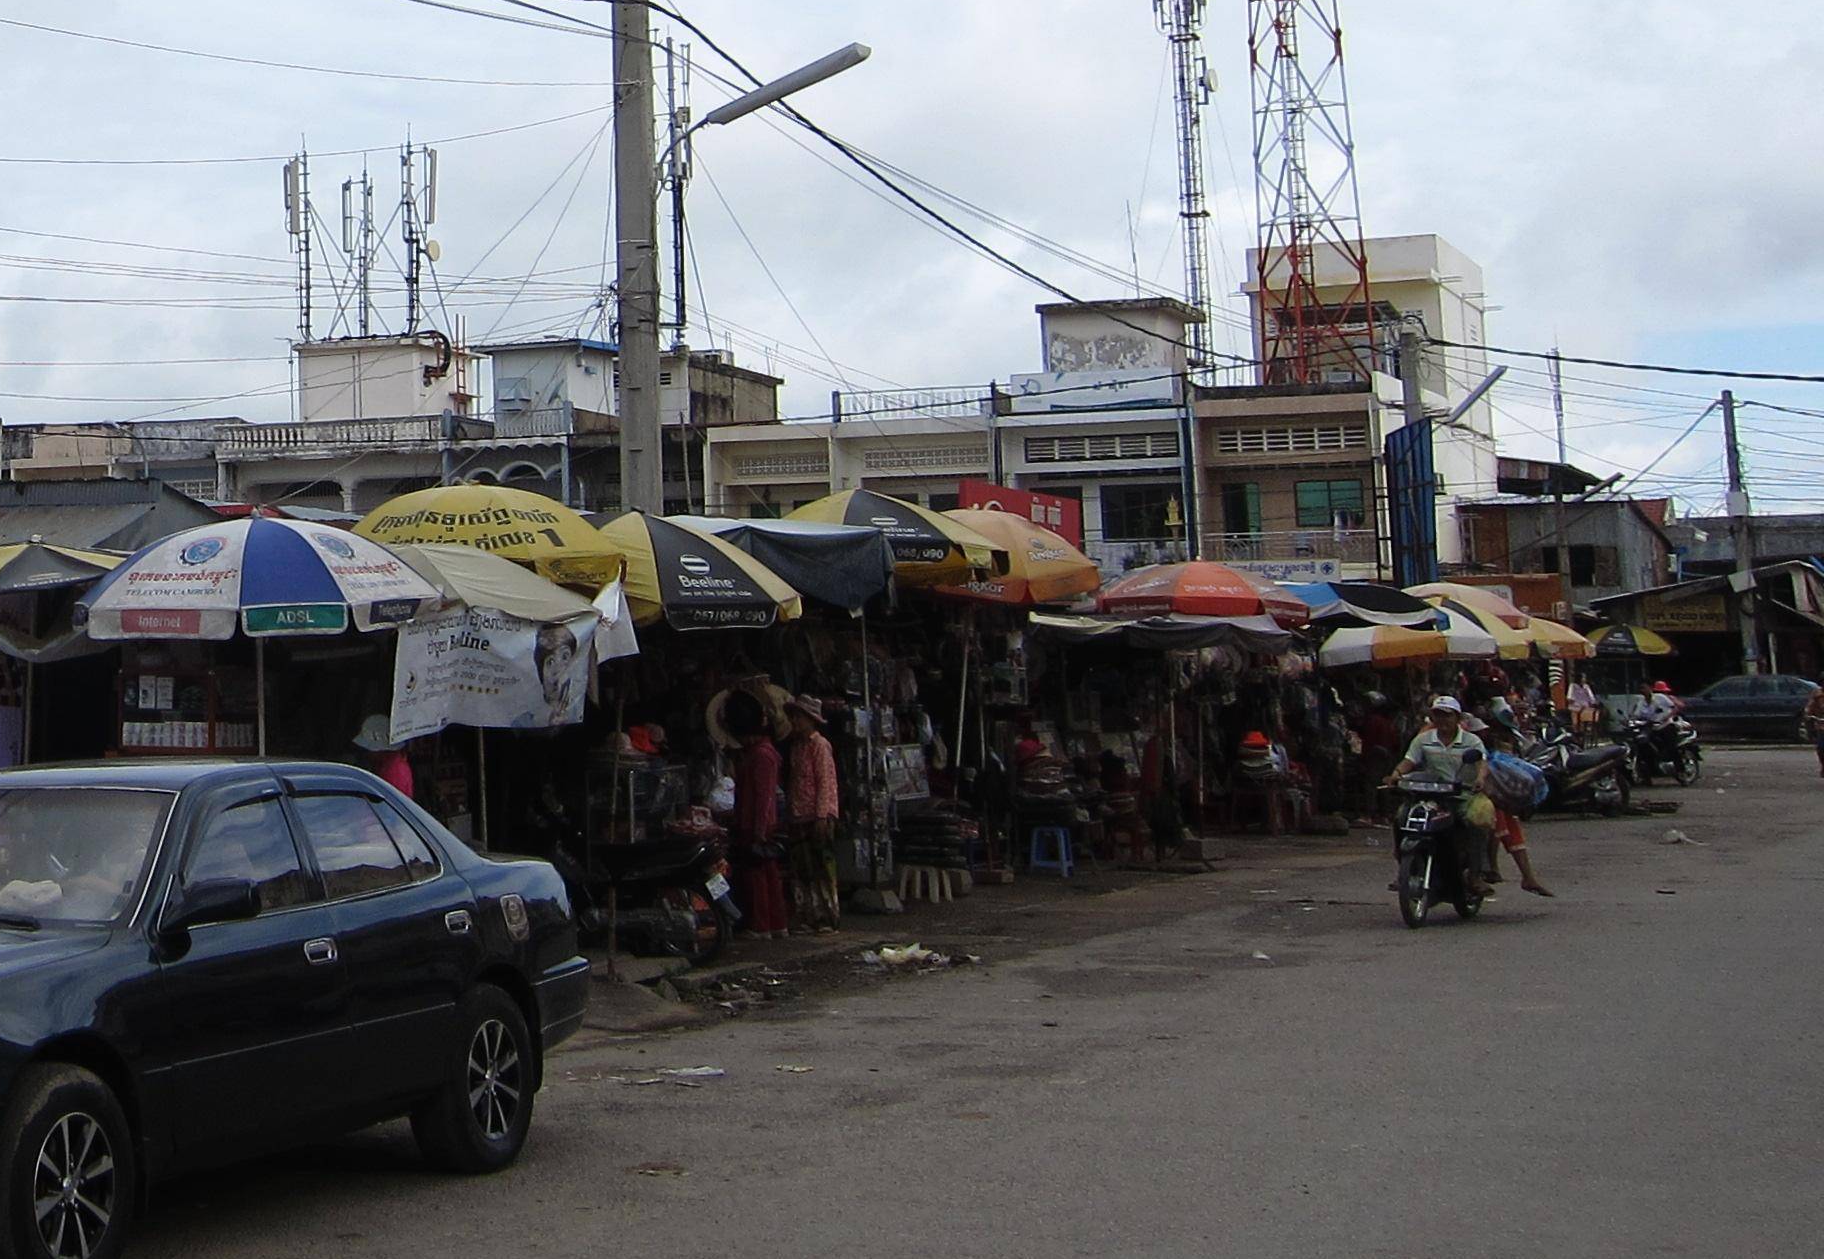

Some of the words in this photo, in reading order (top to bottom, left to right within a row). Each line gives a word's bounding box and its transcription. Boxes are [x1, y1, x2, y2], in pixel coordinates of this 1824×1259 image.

[678, 574, 734, 589] Beeline
[138, 614, 182, 628] Internet
[275, 609, 315, 624] ADSL
